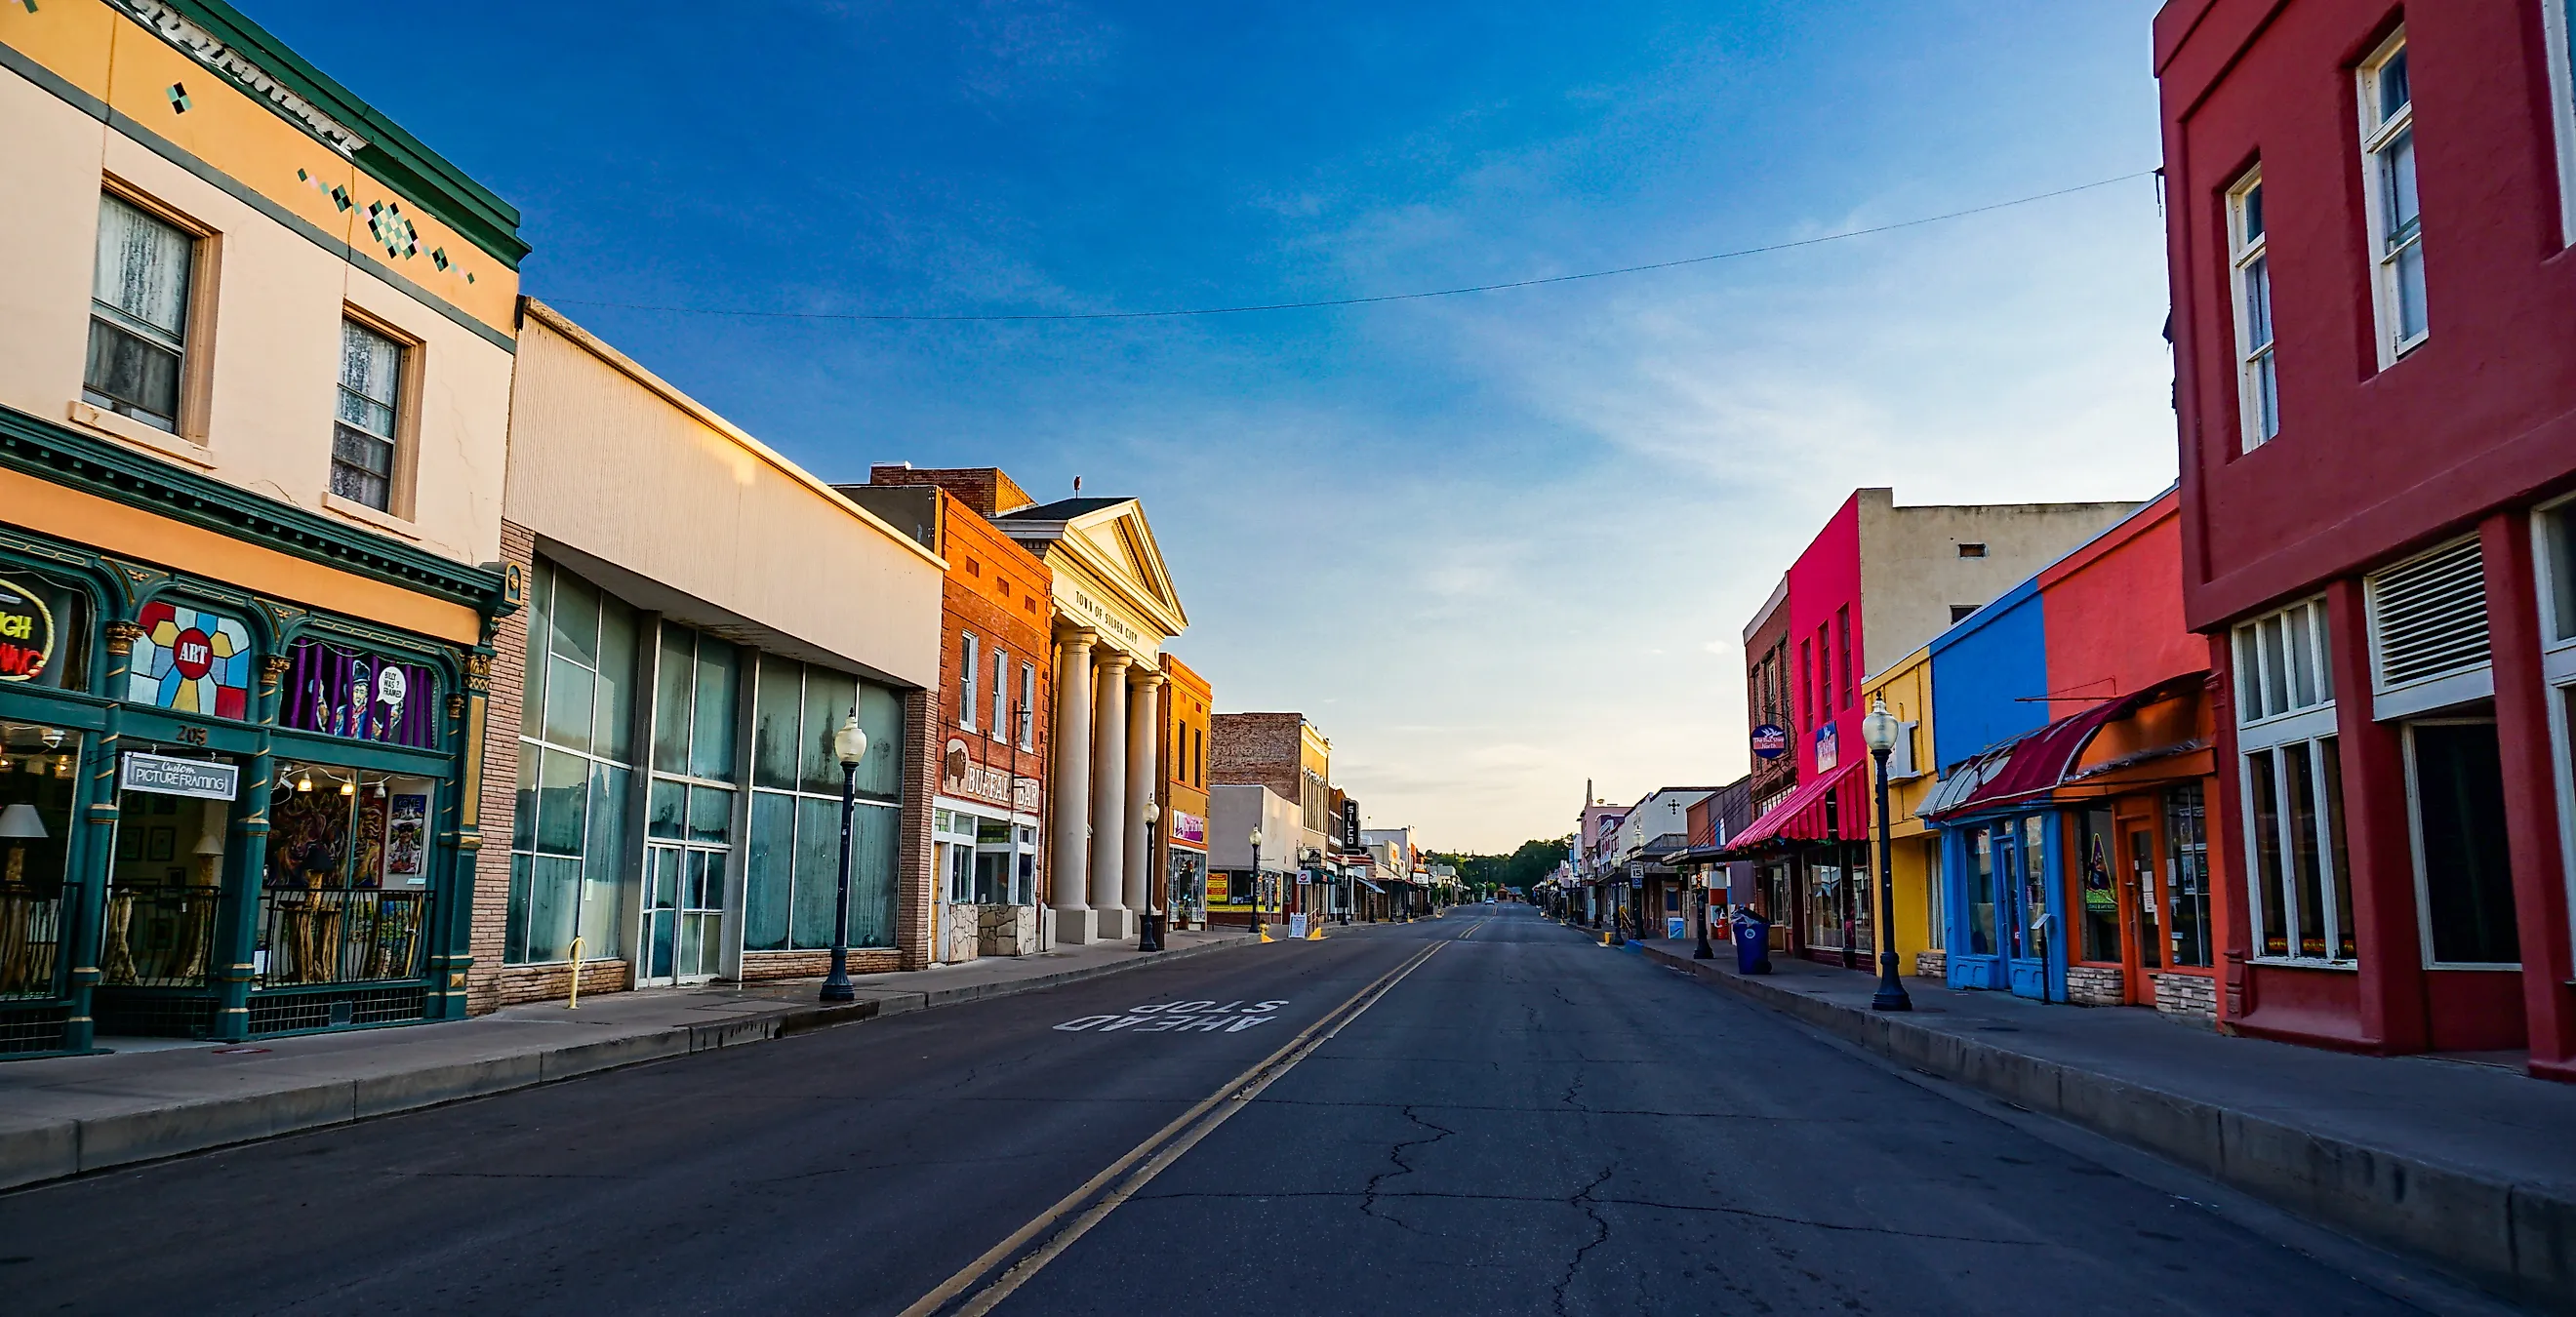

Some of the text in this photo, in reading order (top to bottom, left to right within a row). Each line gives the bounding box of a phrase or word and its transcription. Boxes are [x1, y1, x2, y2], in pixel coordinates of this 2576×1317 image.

[1075, 590, 1138, 644] TOWN OF SILVER CITY
[179, 642, 209, 665] ART
[383, 679, 395, 689] WAS
[177, 724, 208, 745] 205
[161, 761, 196, 775] Custom
[136, 768, 224, 791] PICTURE FRAMING
[967, 767, 1038, 809] BUFFAL BAR
[1129, 1000, 1290, 1014] STOP
[1053, 1015, 1277, 1032] AHEAD
